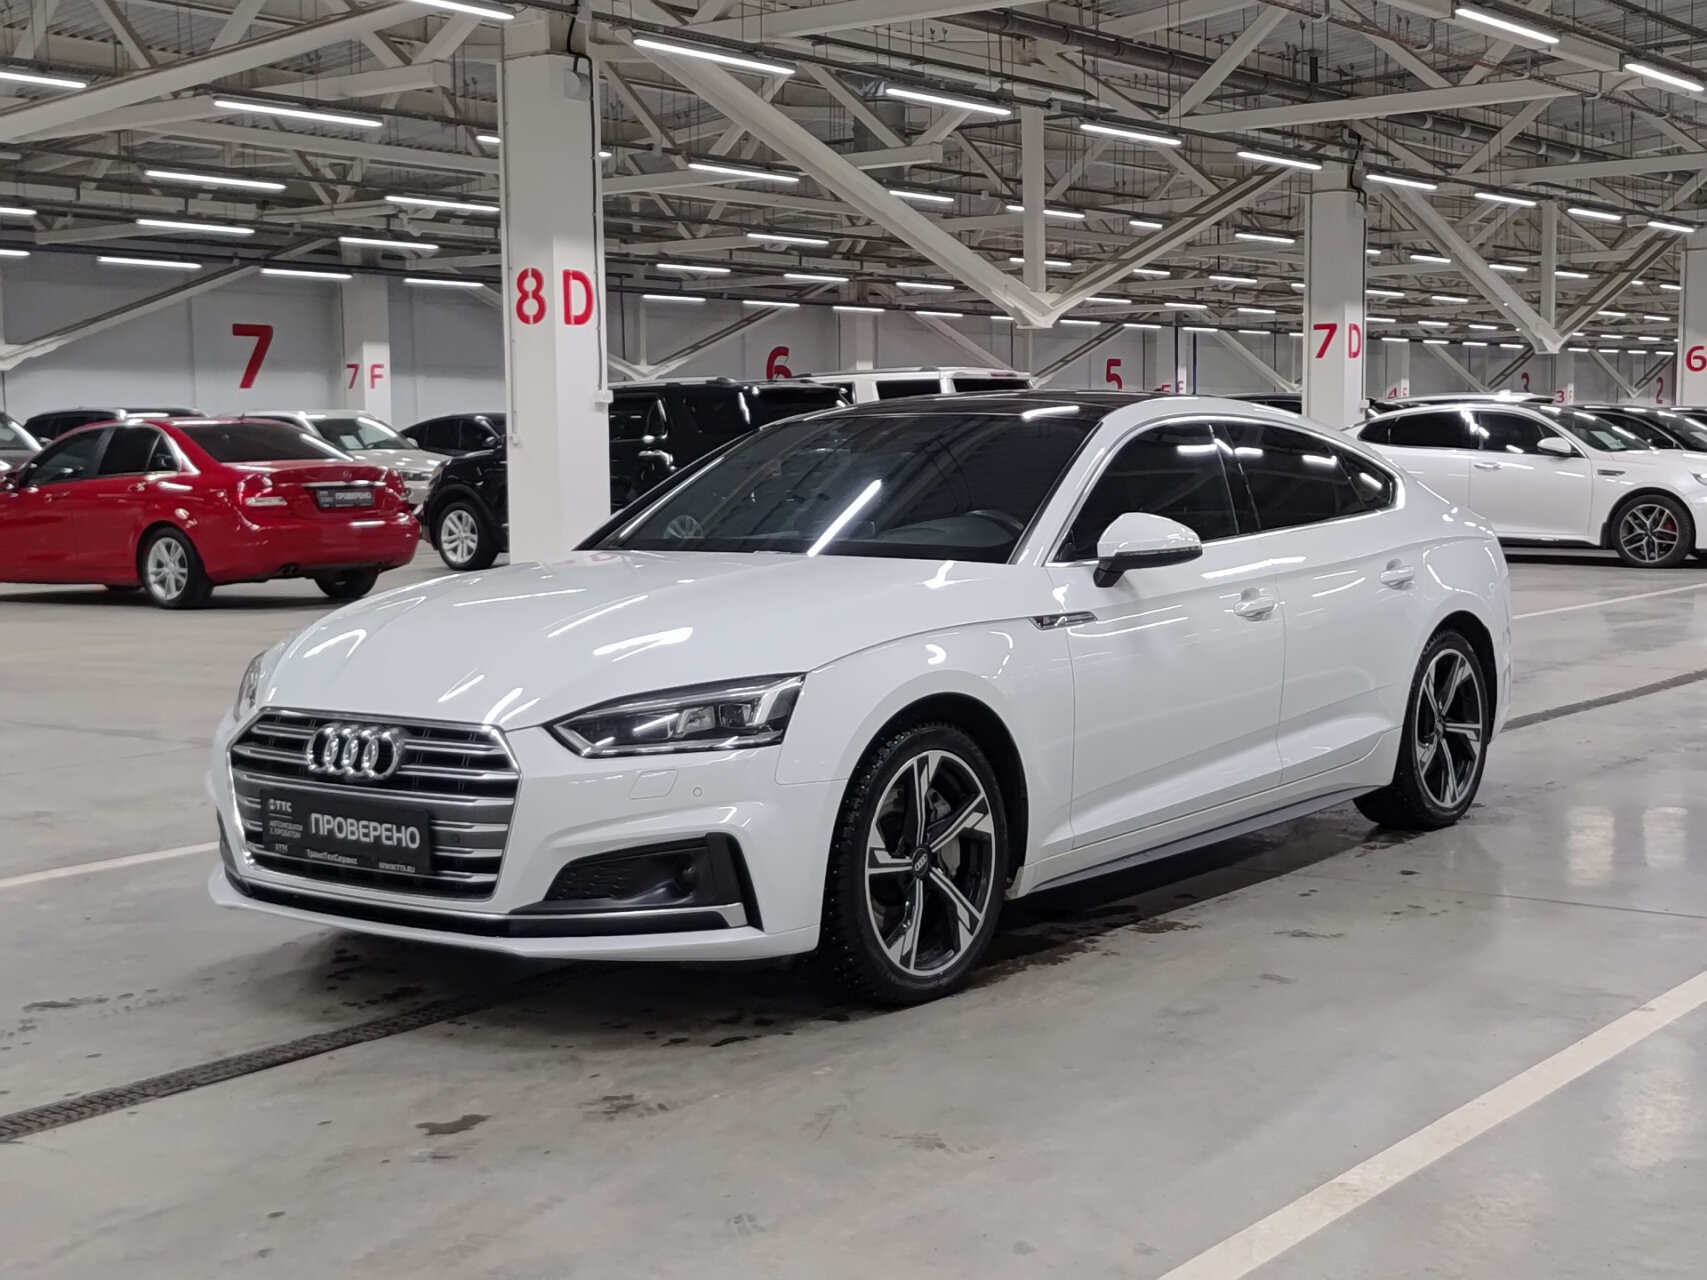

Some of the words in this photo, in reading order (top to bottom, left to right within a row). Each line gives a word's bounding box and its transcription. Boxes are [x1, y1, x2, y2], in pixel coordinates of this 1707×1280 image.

[514, 267, 547, 325] 8
[561, 268, 595, 326] D
[232, 323, 273, 389] 7
[1313, 322, 1338, 360] 7
[1347, 323, 1362, 360] D
[766, 346, 793, 380] 6
[1106, 358, 1123, 390] 5
[1685, 345, 1707, 373] 6
[346, 363, 360, 389] 7
[369, 363, 384, 389] F
[1655, 376, 1664, 405] 2
[1555, 390, 1565, 404] 3
[310, 812, 421, 849] ПРОВЕРЕНО
